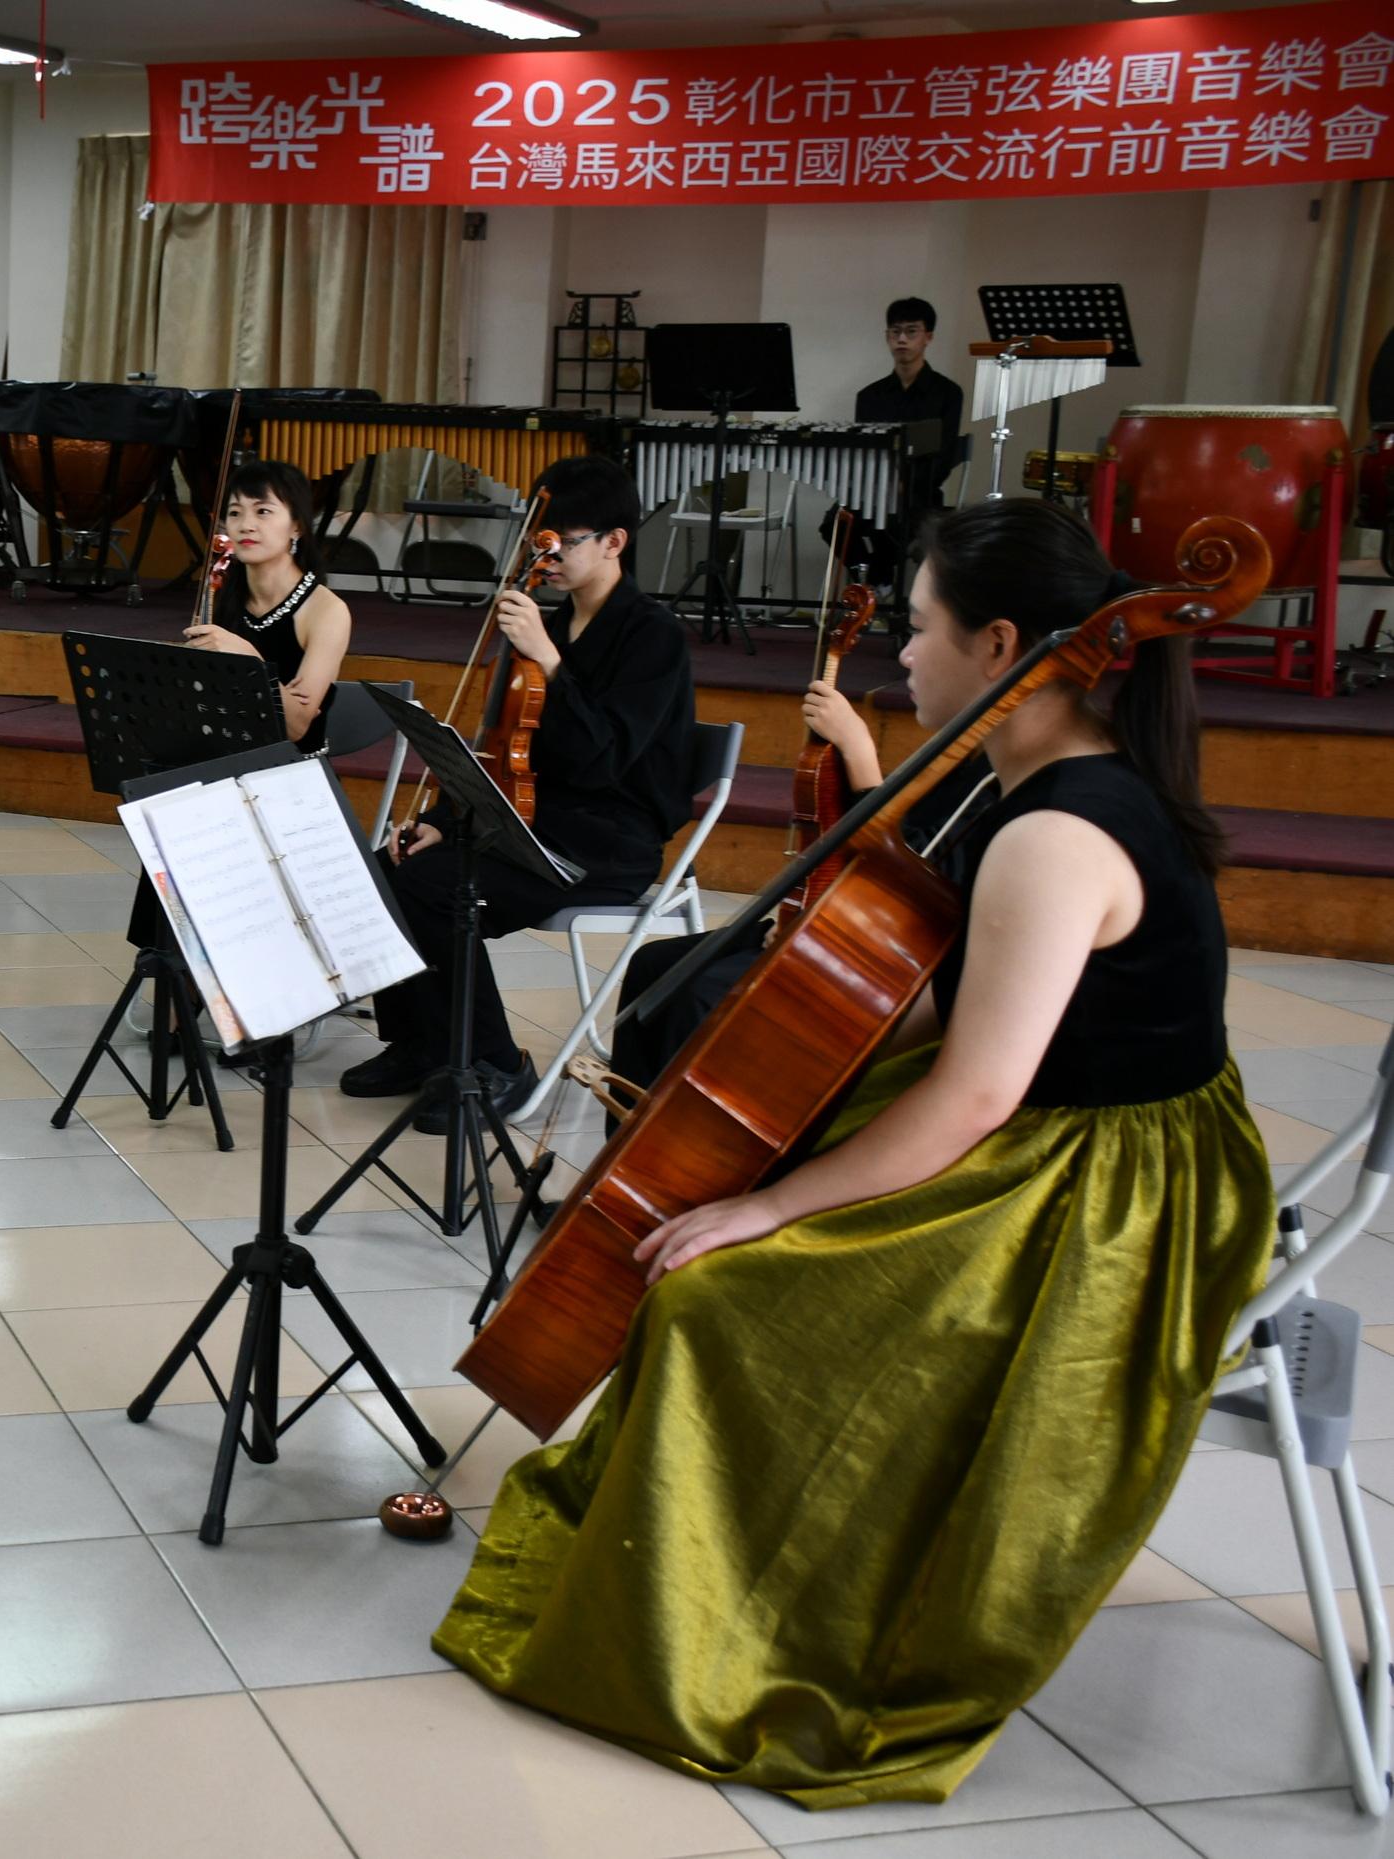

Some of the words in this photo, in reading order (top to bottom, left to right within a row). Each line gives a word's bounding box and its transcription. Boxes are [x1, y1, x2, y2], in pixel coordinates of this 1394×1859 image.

[469, 104, 1390, 190] 台灣馬來西亞國際交流行前音樂會
